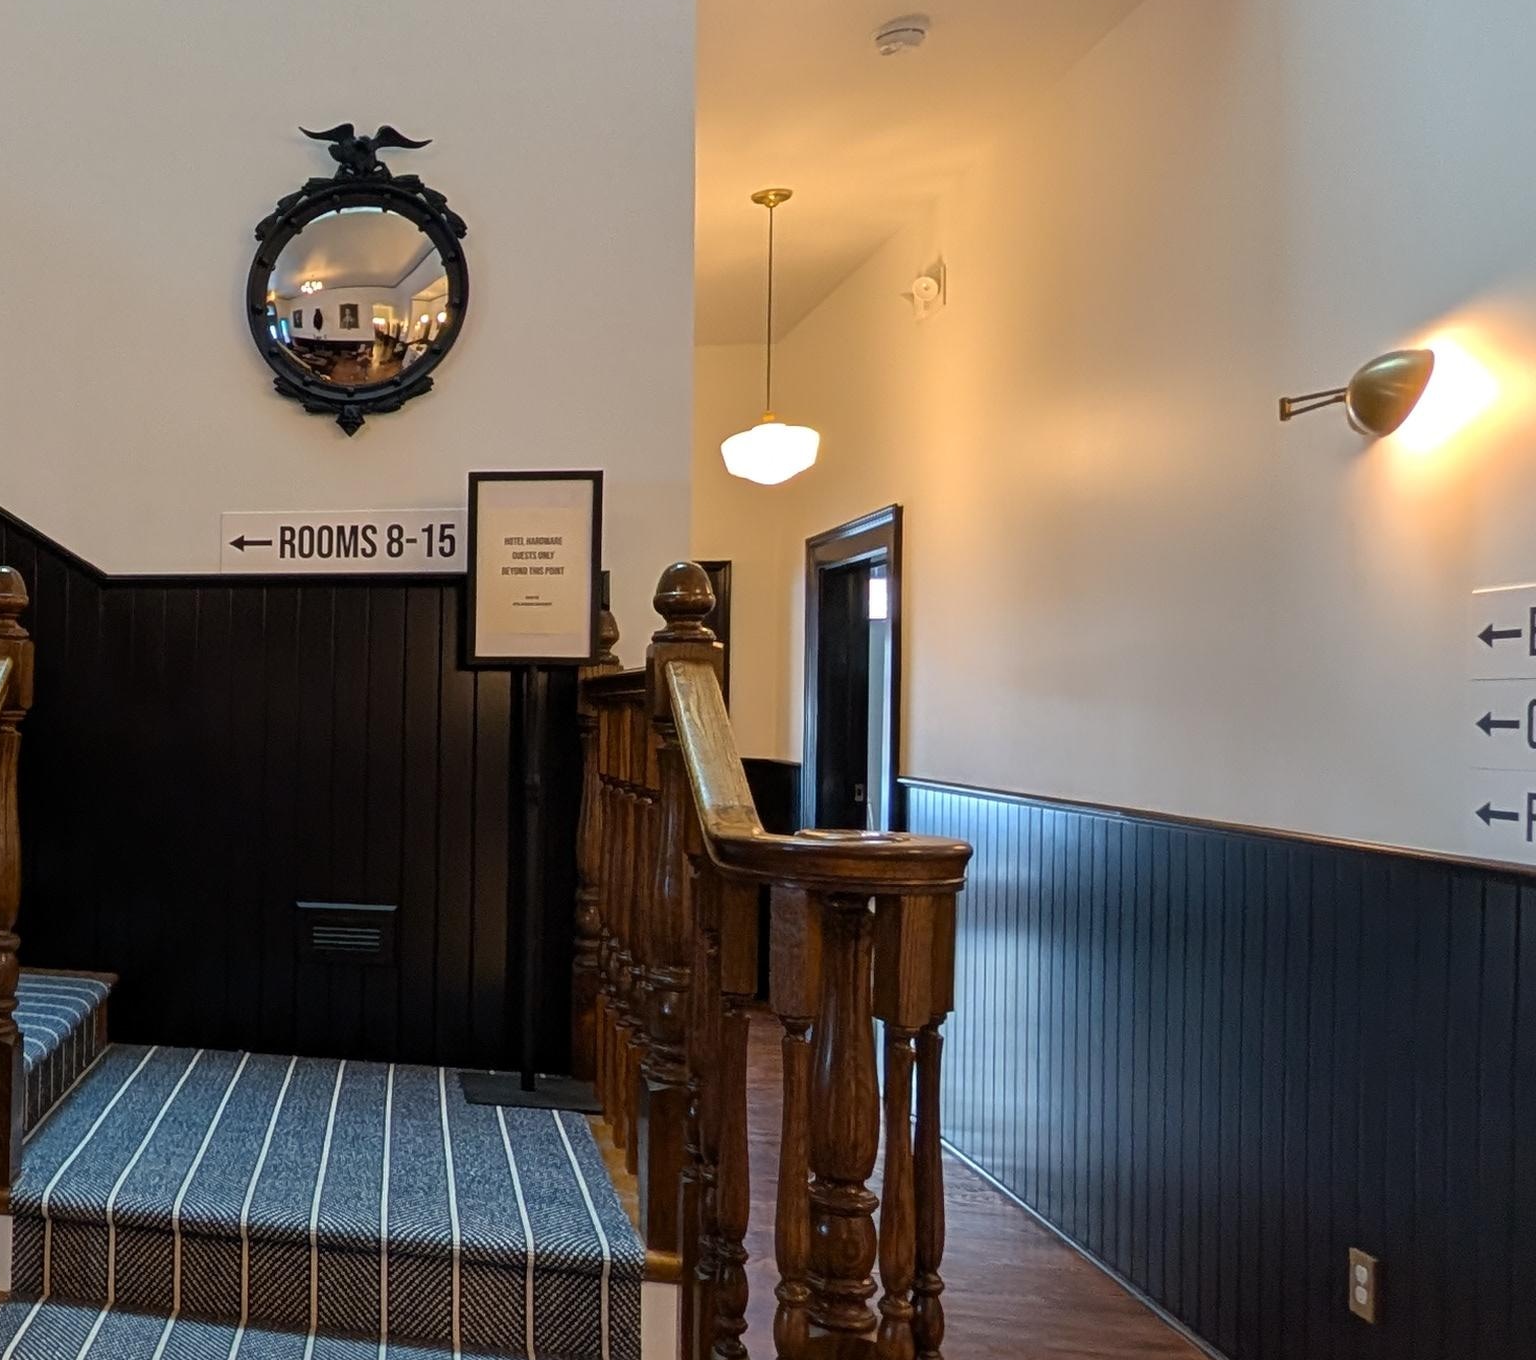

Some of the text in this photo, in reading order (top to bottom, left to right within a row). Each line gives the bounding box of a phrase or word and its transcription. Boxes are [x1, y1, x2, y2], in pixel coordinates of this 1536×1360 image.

[279, 523, 456, 559] ROOMS 8-15
[504, 536, 524, 546] HOTEL
[529, 566, 544, 576] THIS
[545, 566, 565, 576] POINT
